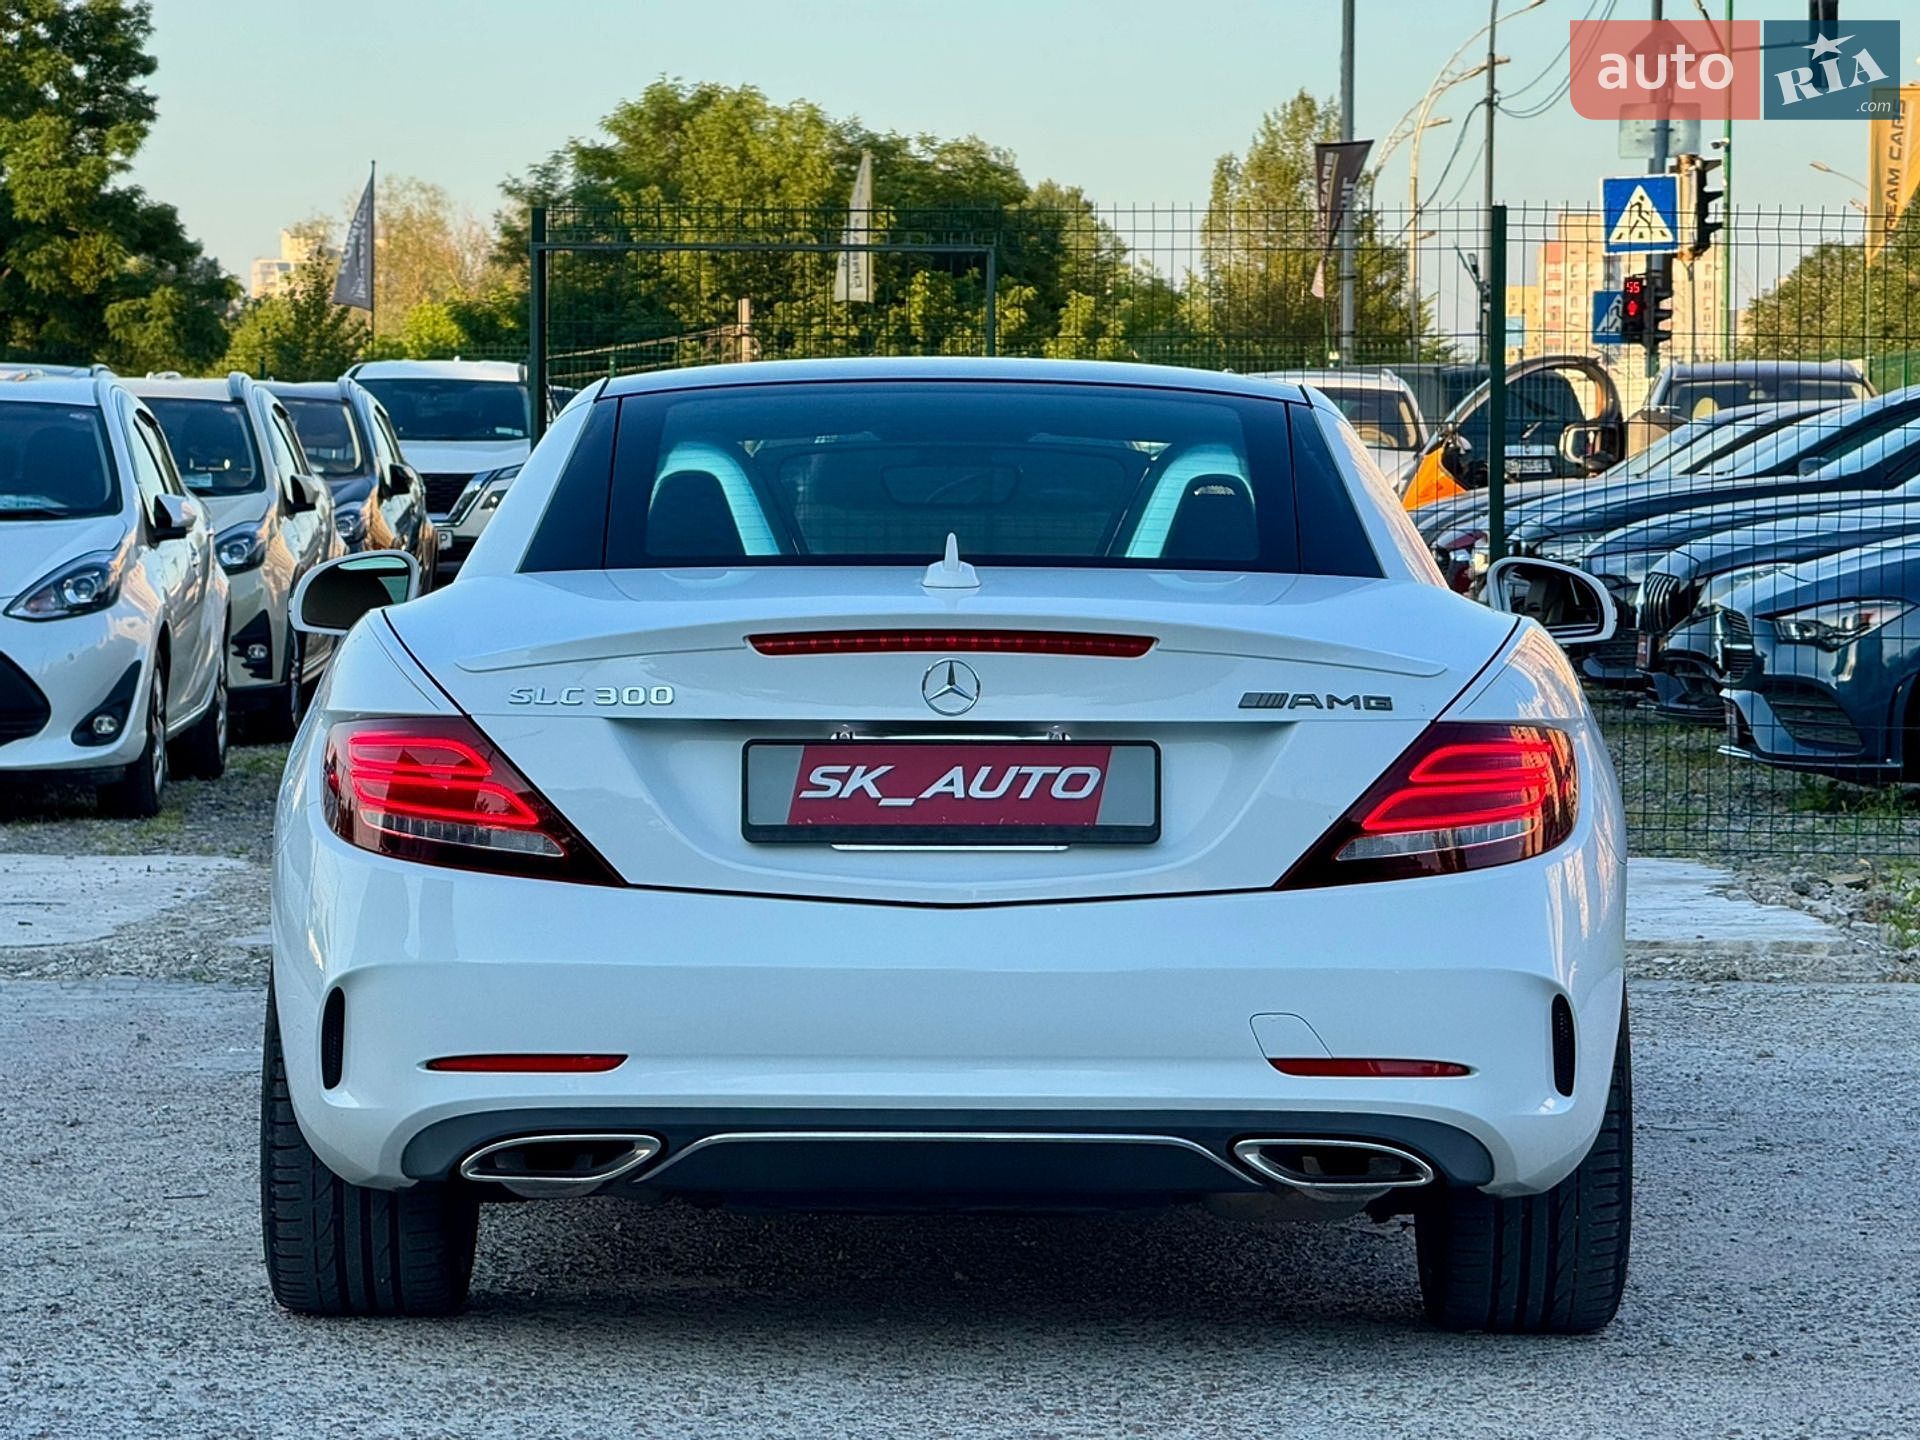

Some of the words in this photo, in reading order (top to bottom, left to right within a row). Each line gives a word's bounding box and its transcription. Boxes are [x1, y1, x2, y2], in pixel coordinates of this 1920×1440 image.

[508, 687, 585, 705] SLC
[593, 686, 675, 706] 300
[1287, 693, 1393, 711] AMG
[798, 765, 1103, 807] SK_AUTO
